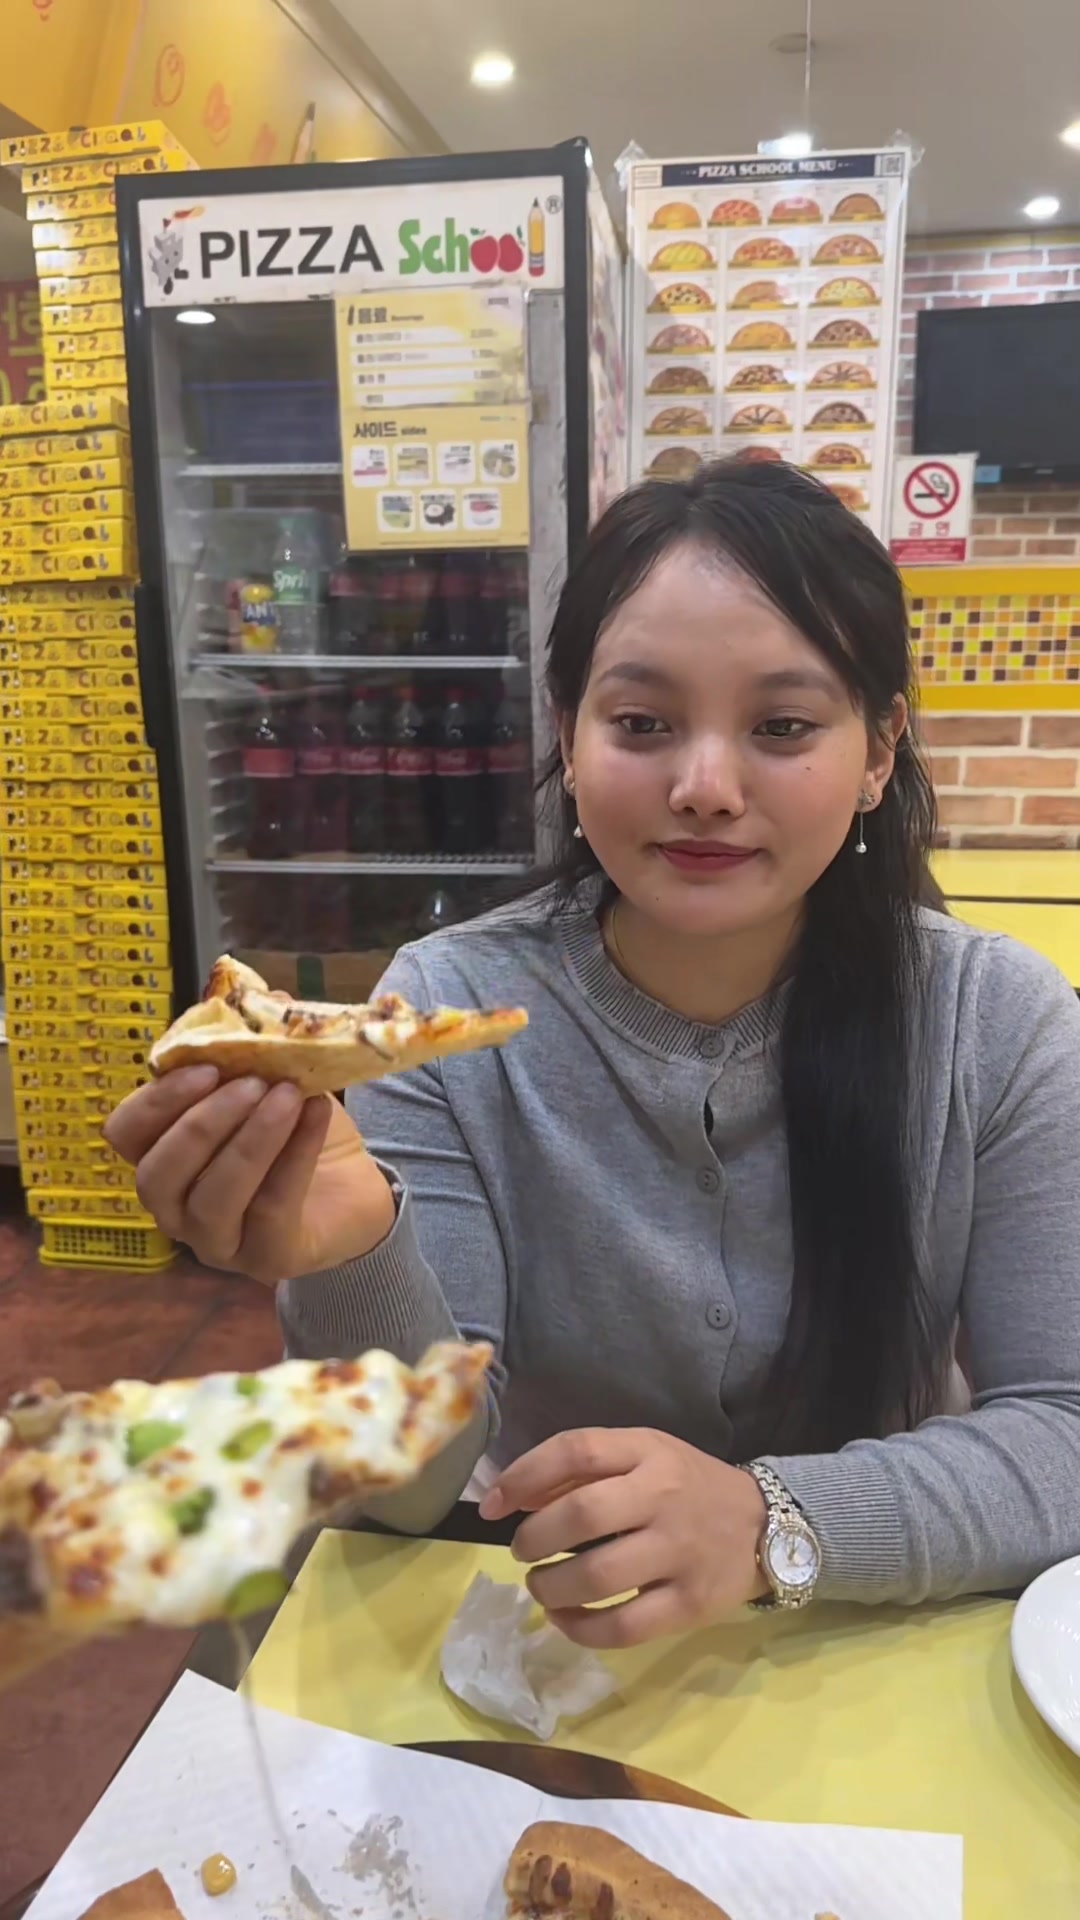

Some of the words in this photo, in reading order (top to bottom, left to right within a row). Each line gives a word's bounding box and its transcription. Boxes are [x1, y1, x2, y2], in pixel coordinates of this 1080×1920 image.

[698, 165, 736, 178] PIZZA
[740, 162, 795, 176] SCHOOL
[798, 159, 837, 173] MENU
[199, 224, 383, 279] PIZZA
[353, 421, 398, 438] 사이드
[273, 569, 306, 592] Spri
